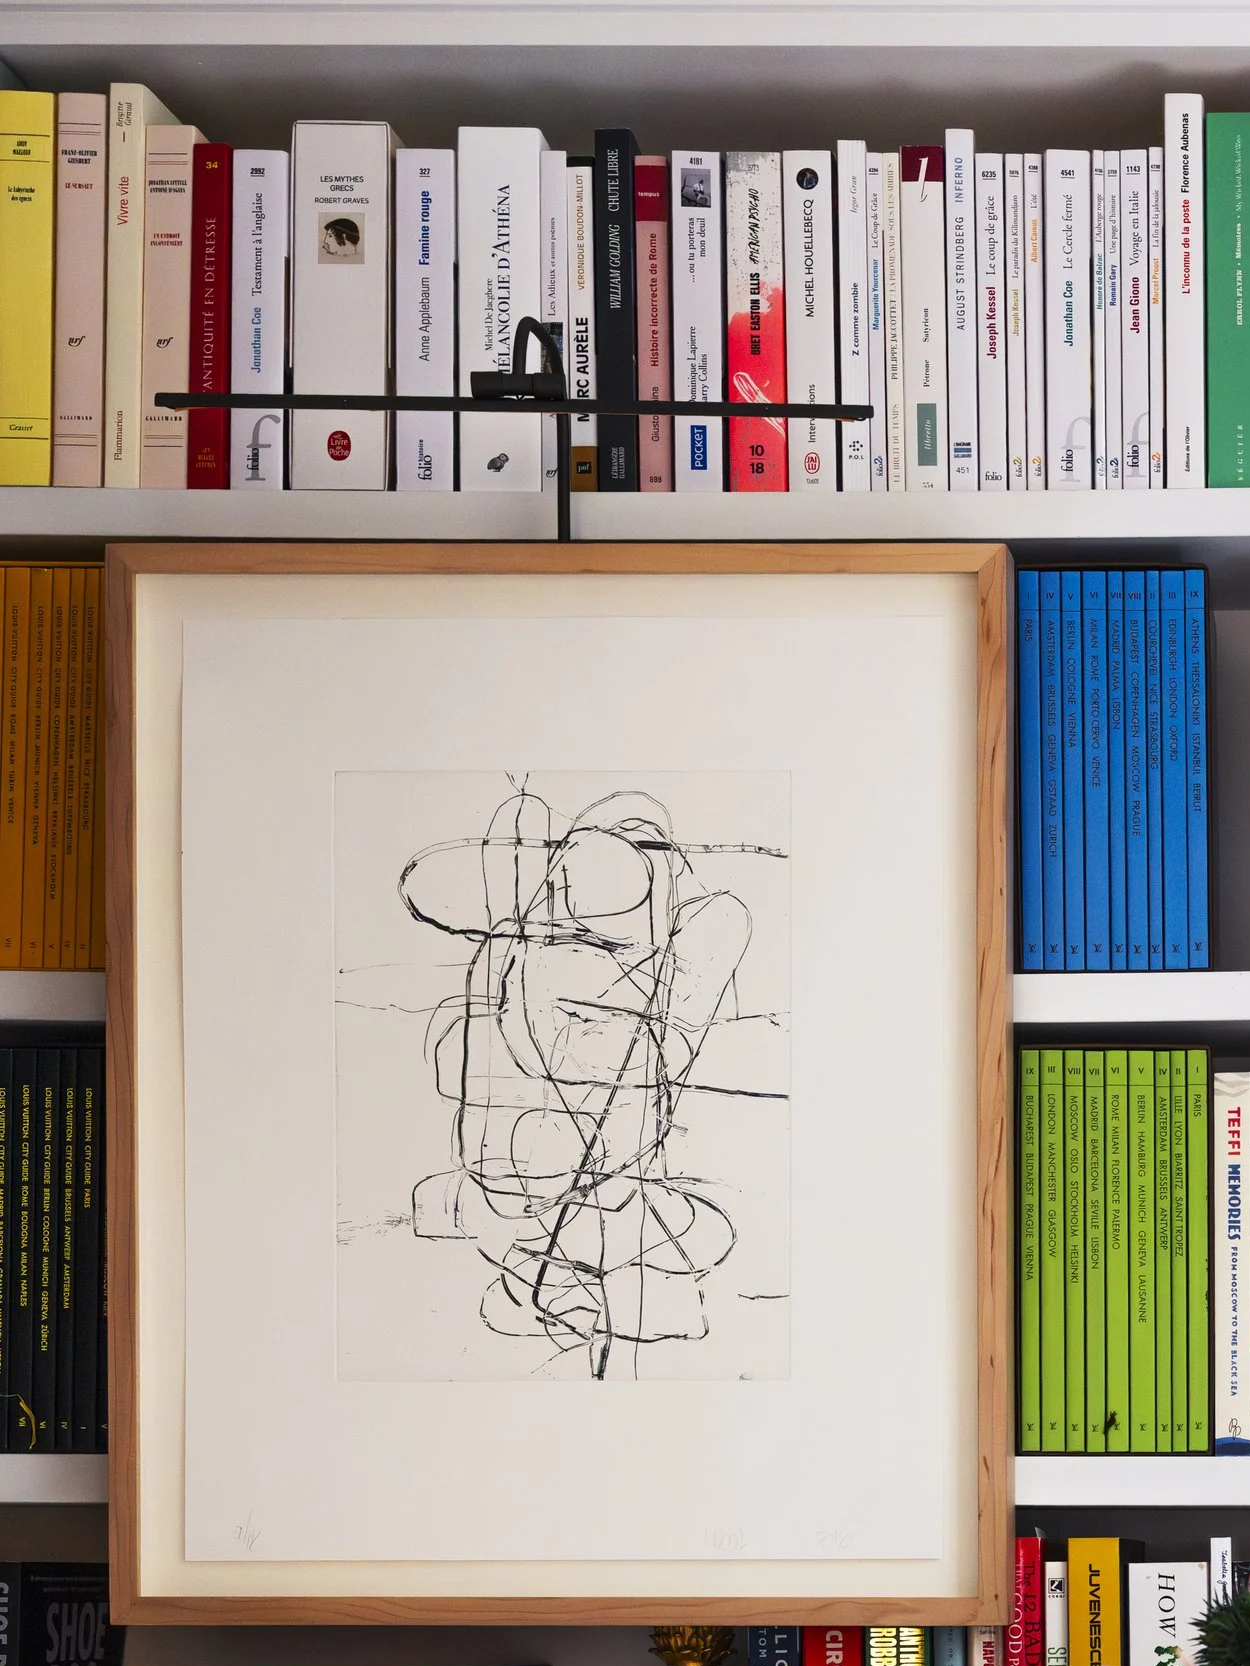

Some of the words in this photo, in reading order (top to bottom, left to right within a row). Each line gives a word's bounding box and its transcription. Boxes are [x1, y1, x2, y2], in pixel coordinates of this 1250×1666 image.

[1181, 113, 1189, 151] Aubenas
[607, 149, 618, 176] LIBRE
[955, 158, 963, 202] INFERNO
[1181, 154, 1189, 193] Florence
[119, 177, 129, 195] vite
[608, 179, 619, 211] CHUTE
[117, 199, 128, 225] Vivre
[252, 193, 265, 235] l'anglaise
[421, 191, 432, 222] rouge
[419, 226, 429, 265] Famine
[609, 225, 620, 267] GOLDING
[649, 233, 657, 260] Rome
[803, 200, 814, 274] HOUELLEBECQ
[955, 217, 964, 283] STRINDBERG
[252, 247, 262, 296] Testament
[610, 269, 621, 308] WILLIAM
[649, 263, 657, 274] de
[252, 308, 261, 324] Coe
[419, 277, 432, 333] Applebaum
[649, 278, 658, 326] incorrecte
[805, 278, 814, 317] MICHEL
[956, 289, 965, 330] AUGUST
[251, 328, 261, 373] Jonathan
[419, 336, 430, 361] Anne
[650, 330, 659, 366] Histoire
[114, 411, 123, 460] Flammarion
[1048, 1094, 1056, 1134] LONDON
[1228, 1107, 1241, 1155] TEFFI
[1048, 1143, 1056, 1201] MANCHESTER
[1228, 1164, 1241, 1240] MEMORIES
[1048, 1210, 1056, 1257] GLASGOW
[1158, 1573, 1175, 1637] HOW
